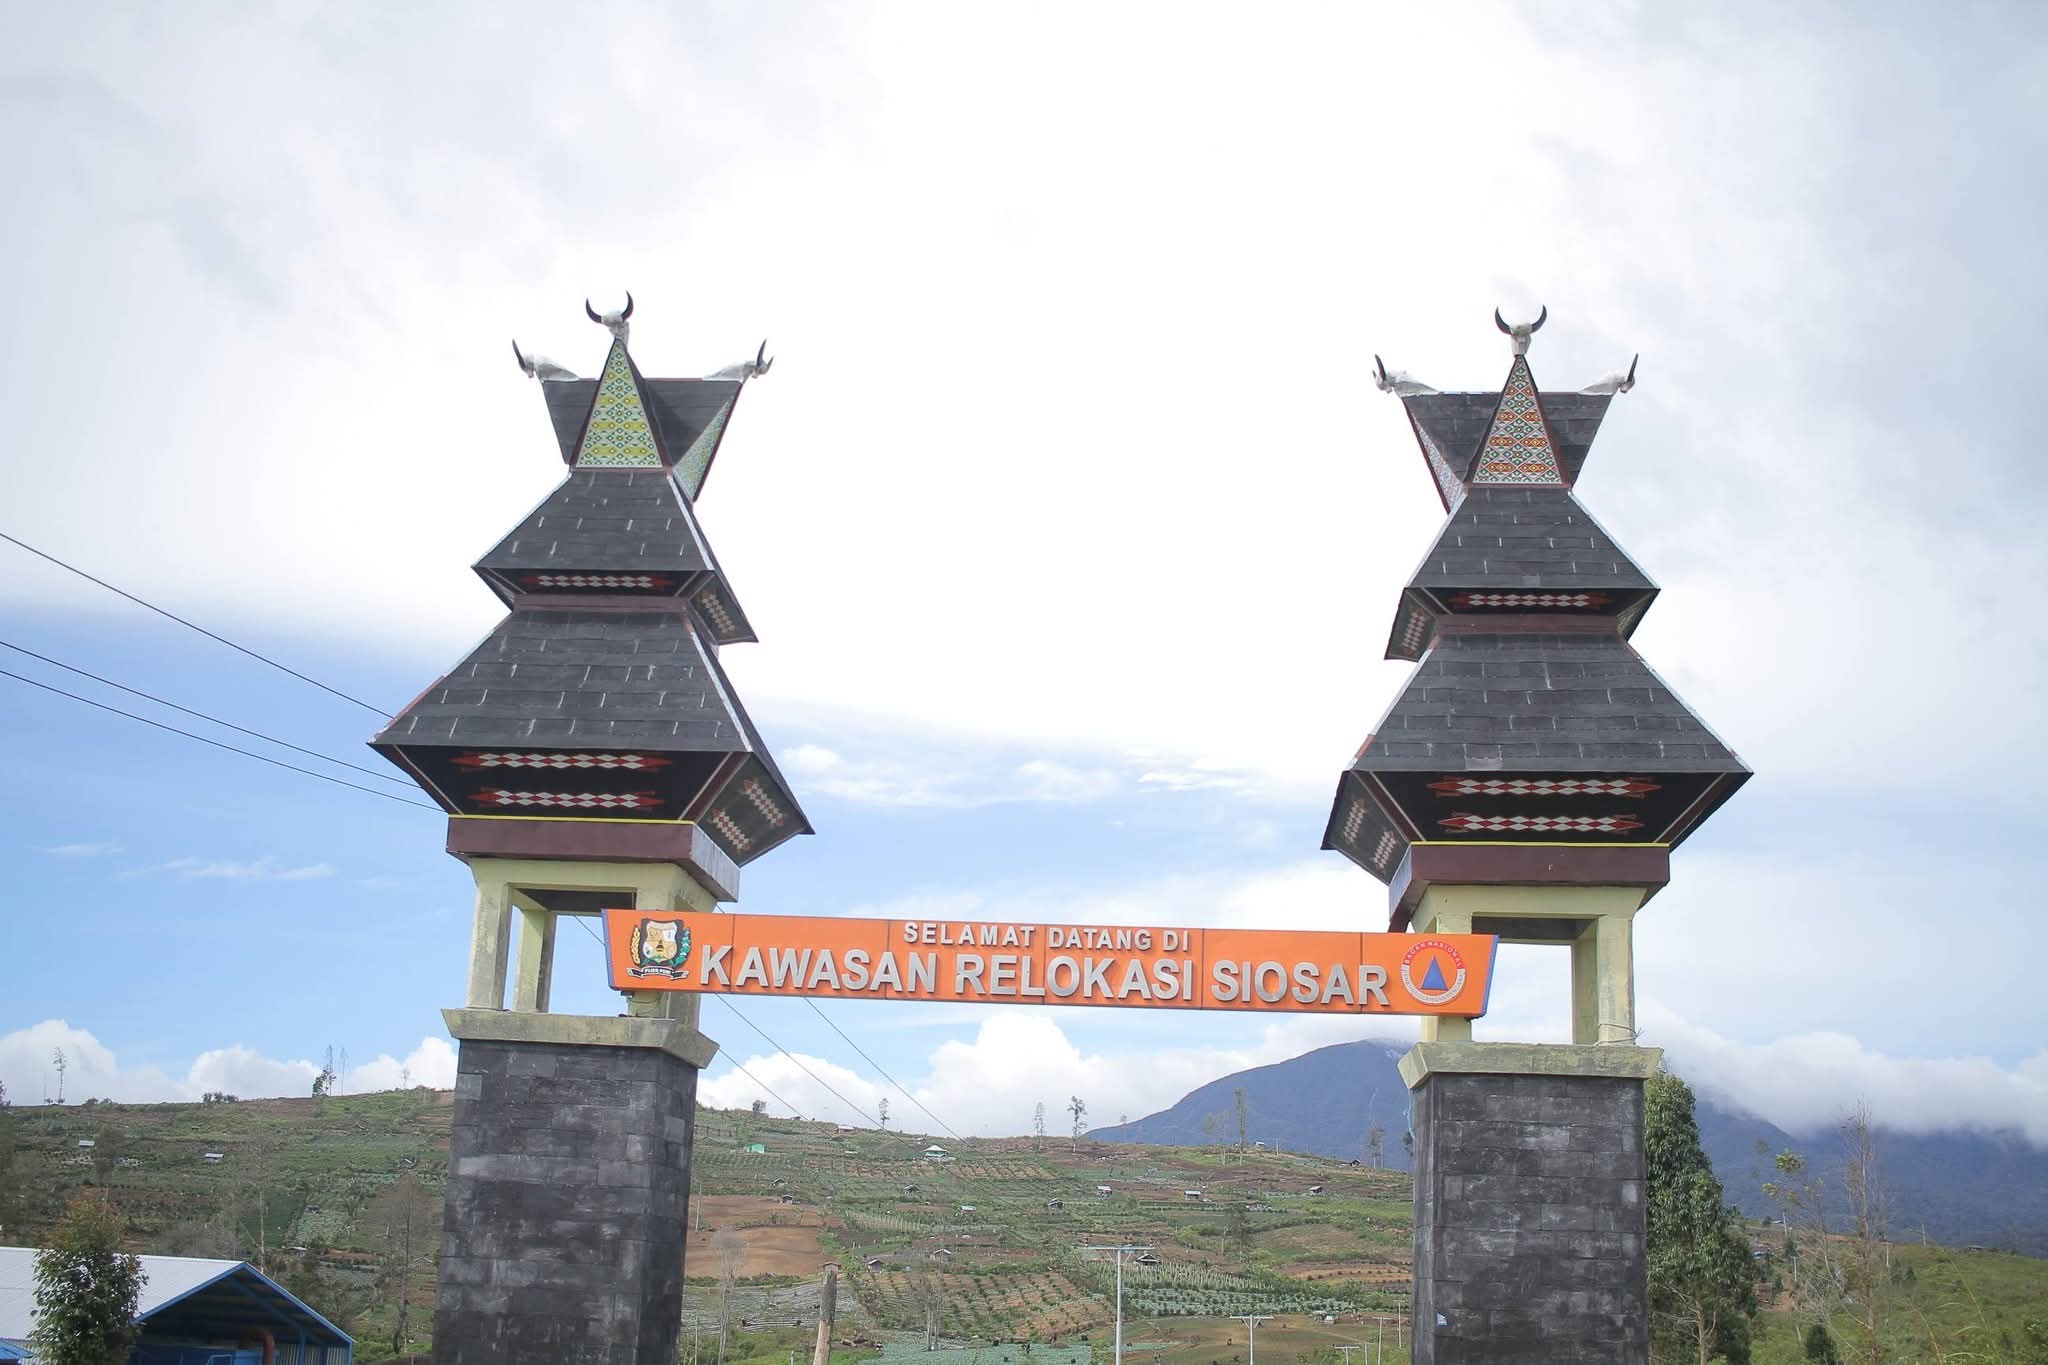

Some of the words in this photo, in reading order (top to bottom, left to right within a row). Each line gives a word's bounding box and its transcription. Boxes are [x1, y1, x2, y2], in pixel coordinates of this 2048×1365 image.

[904, 921, 1035, 947] SELAMAT
[1048, 927, 1151, 951] DATANG
[1163, 931, 1189, 951] DI
[701, 944, 937, 993] KAWASAN
[955, 954, 1193, 1001] RELOKASI
[1212, 960, 1390, 1006] SIOSAR
